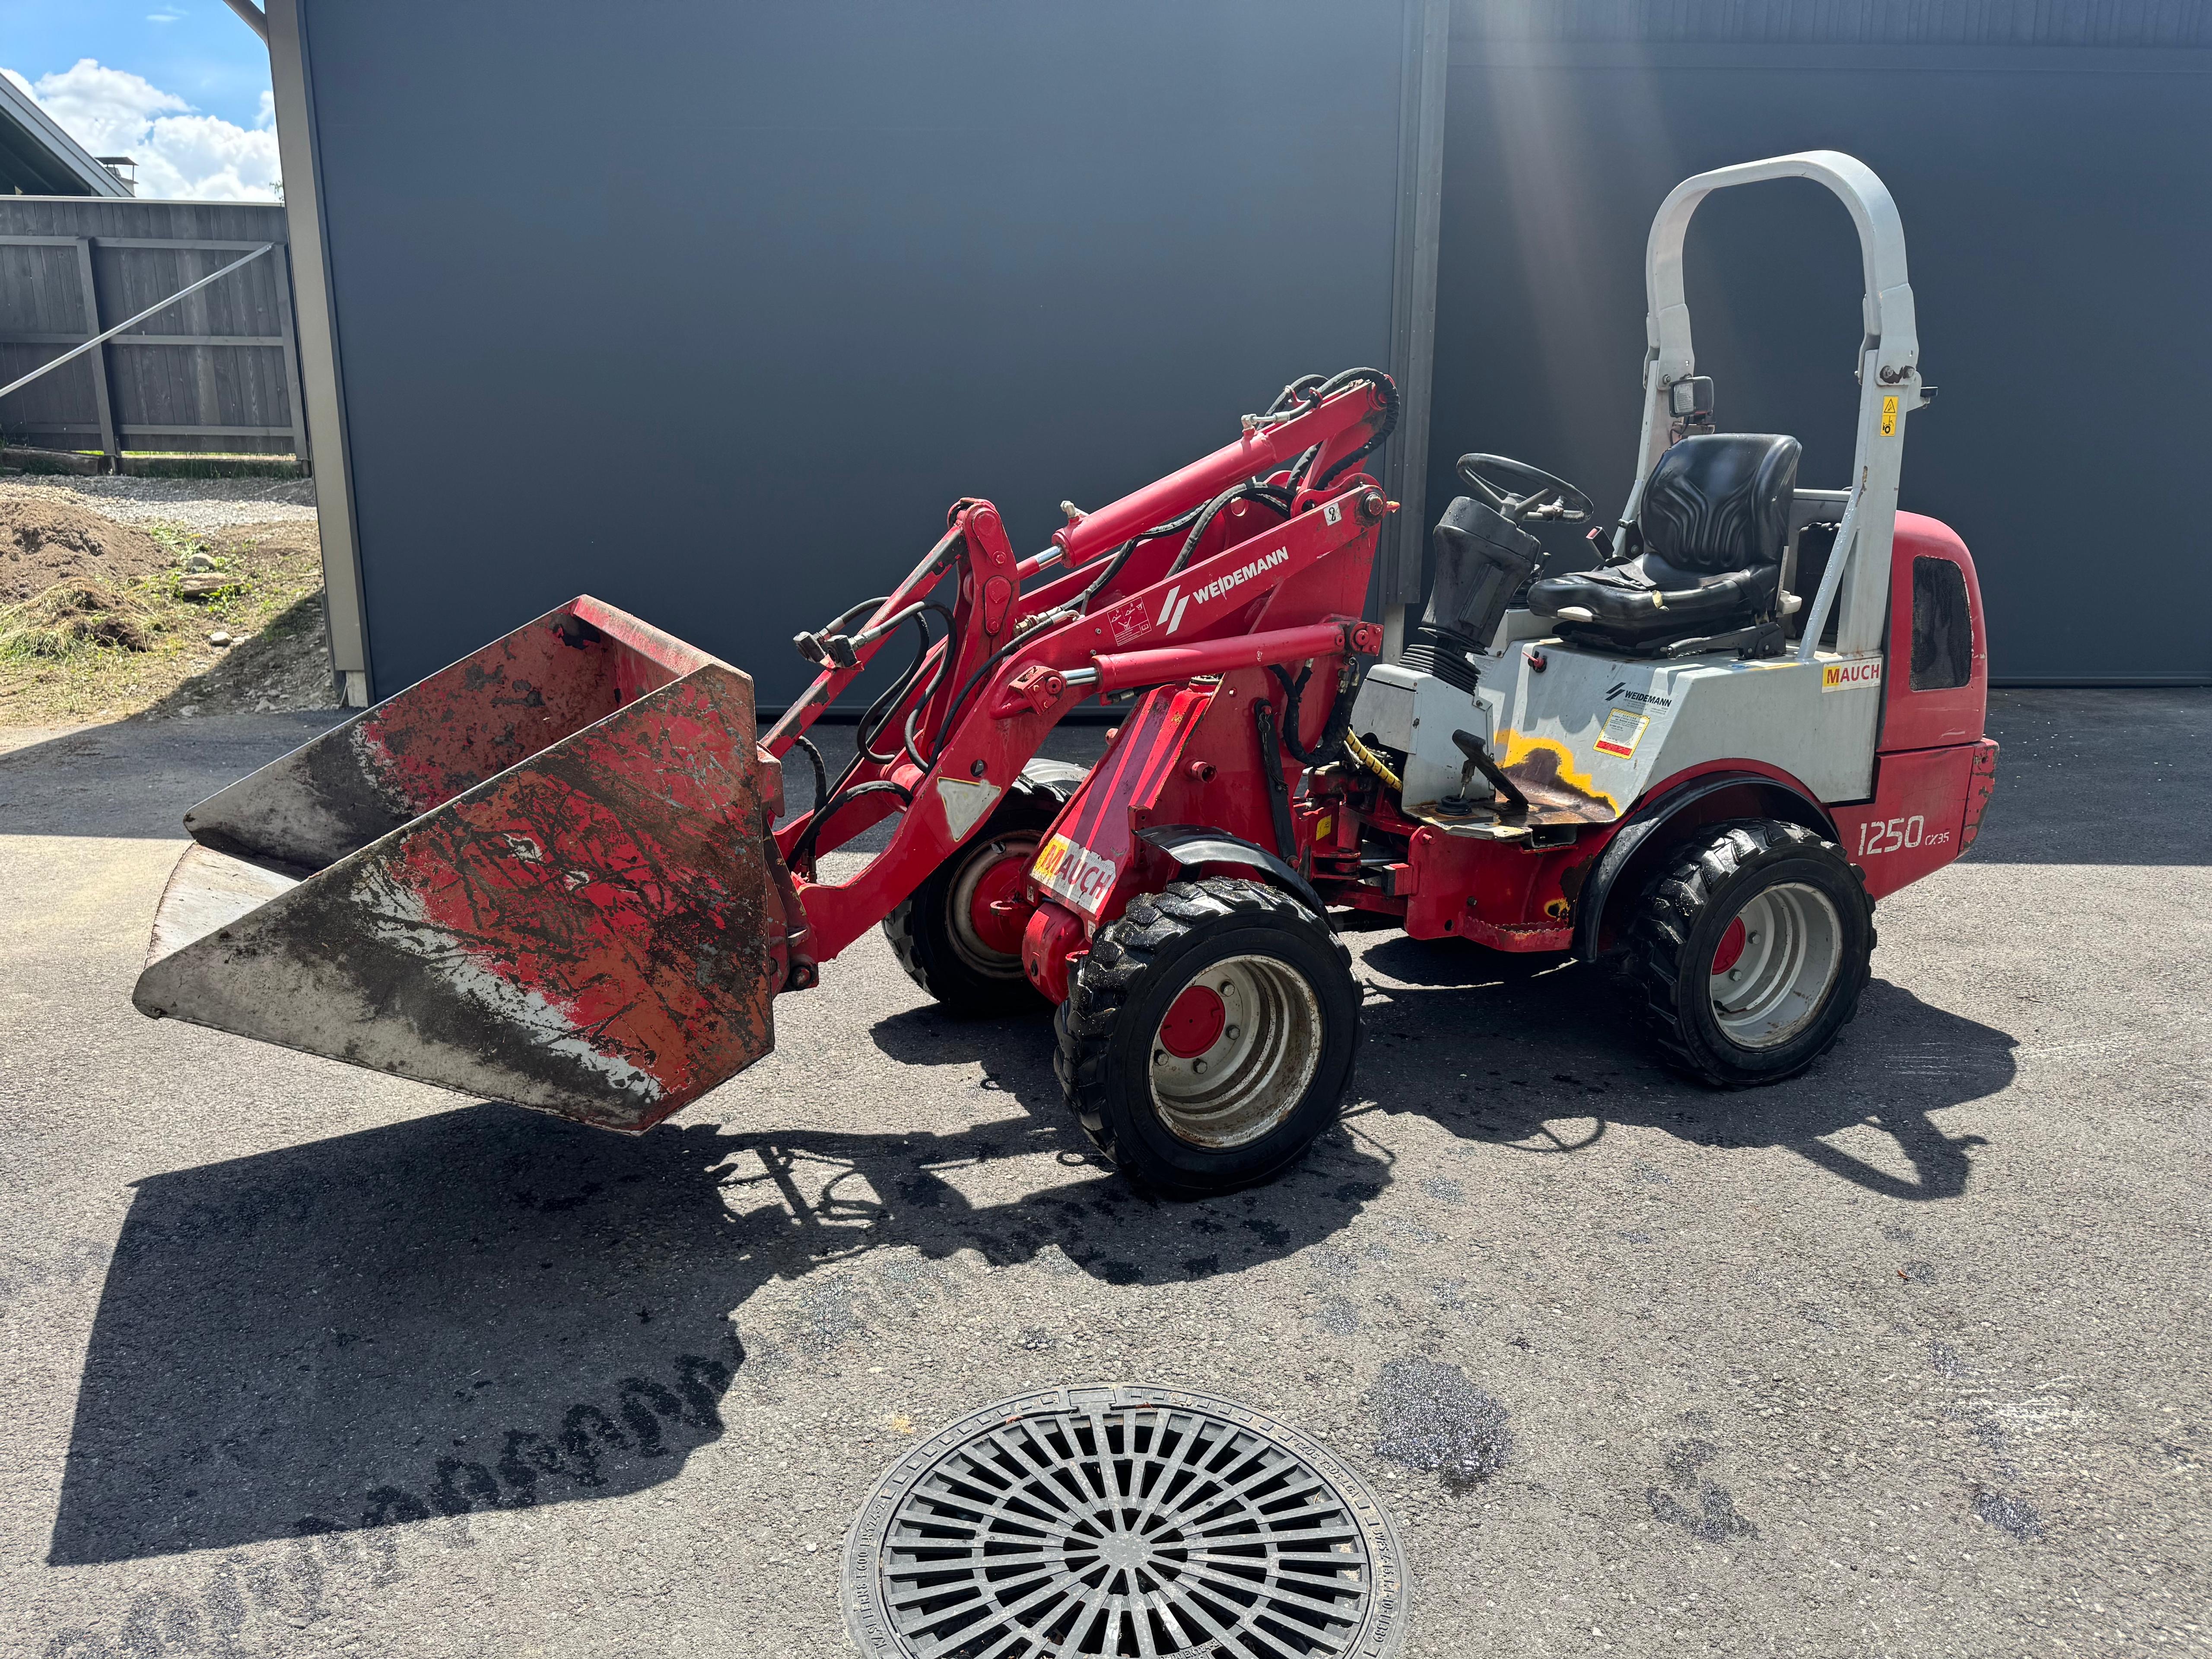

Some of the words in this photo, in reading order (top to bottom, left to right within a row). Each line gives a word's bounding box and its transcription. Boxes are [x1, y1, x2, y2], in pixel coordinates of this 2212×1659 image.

[1192, 546, 1289, 604] WEIDEMANN
[1827, 664, 1880, 684] MAUCH
[1624, 690, 1672, 707] WEIDEMANN
[1858, 815, 1924, 856] 1250
[1041, 845, 1112, 899] MAUCH
